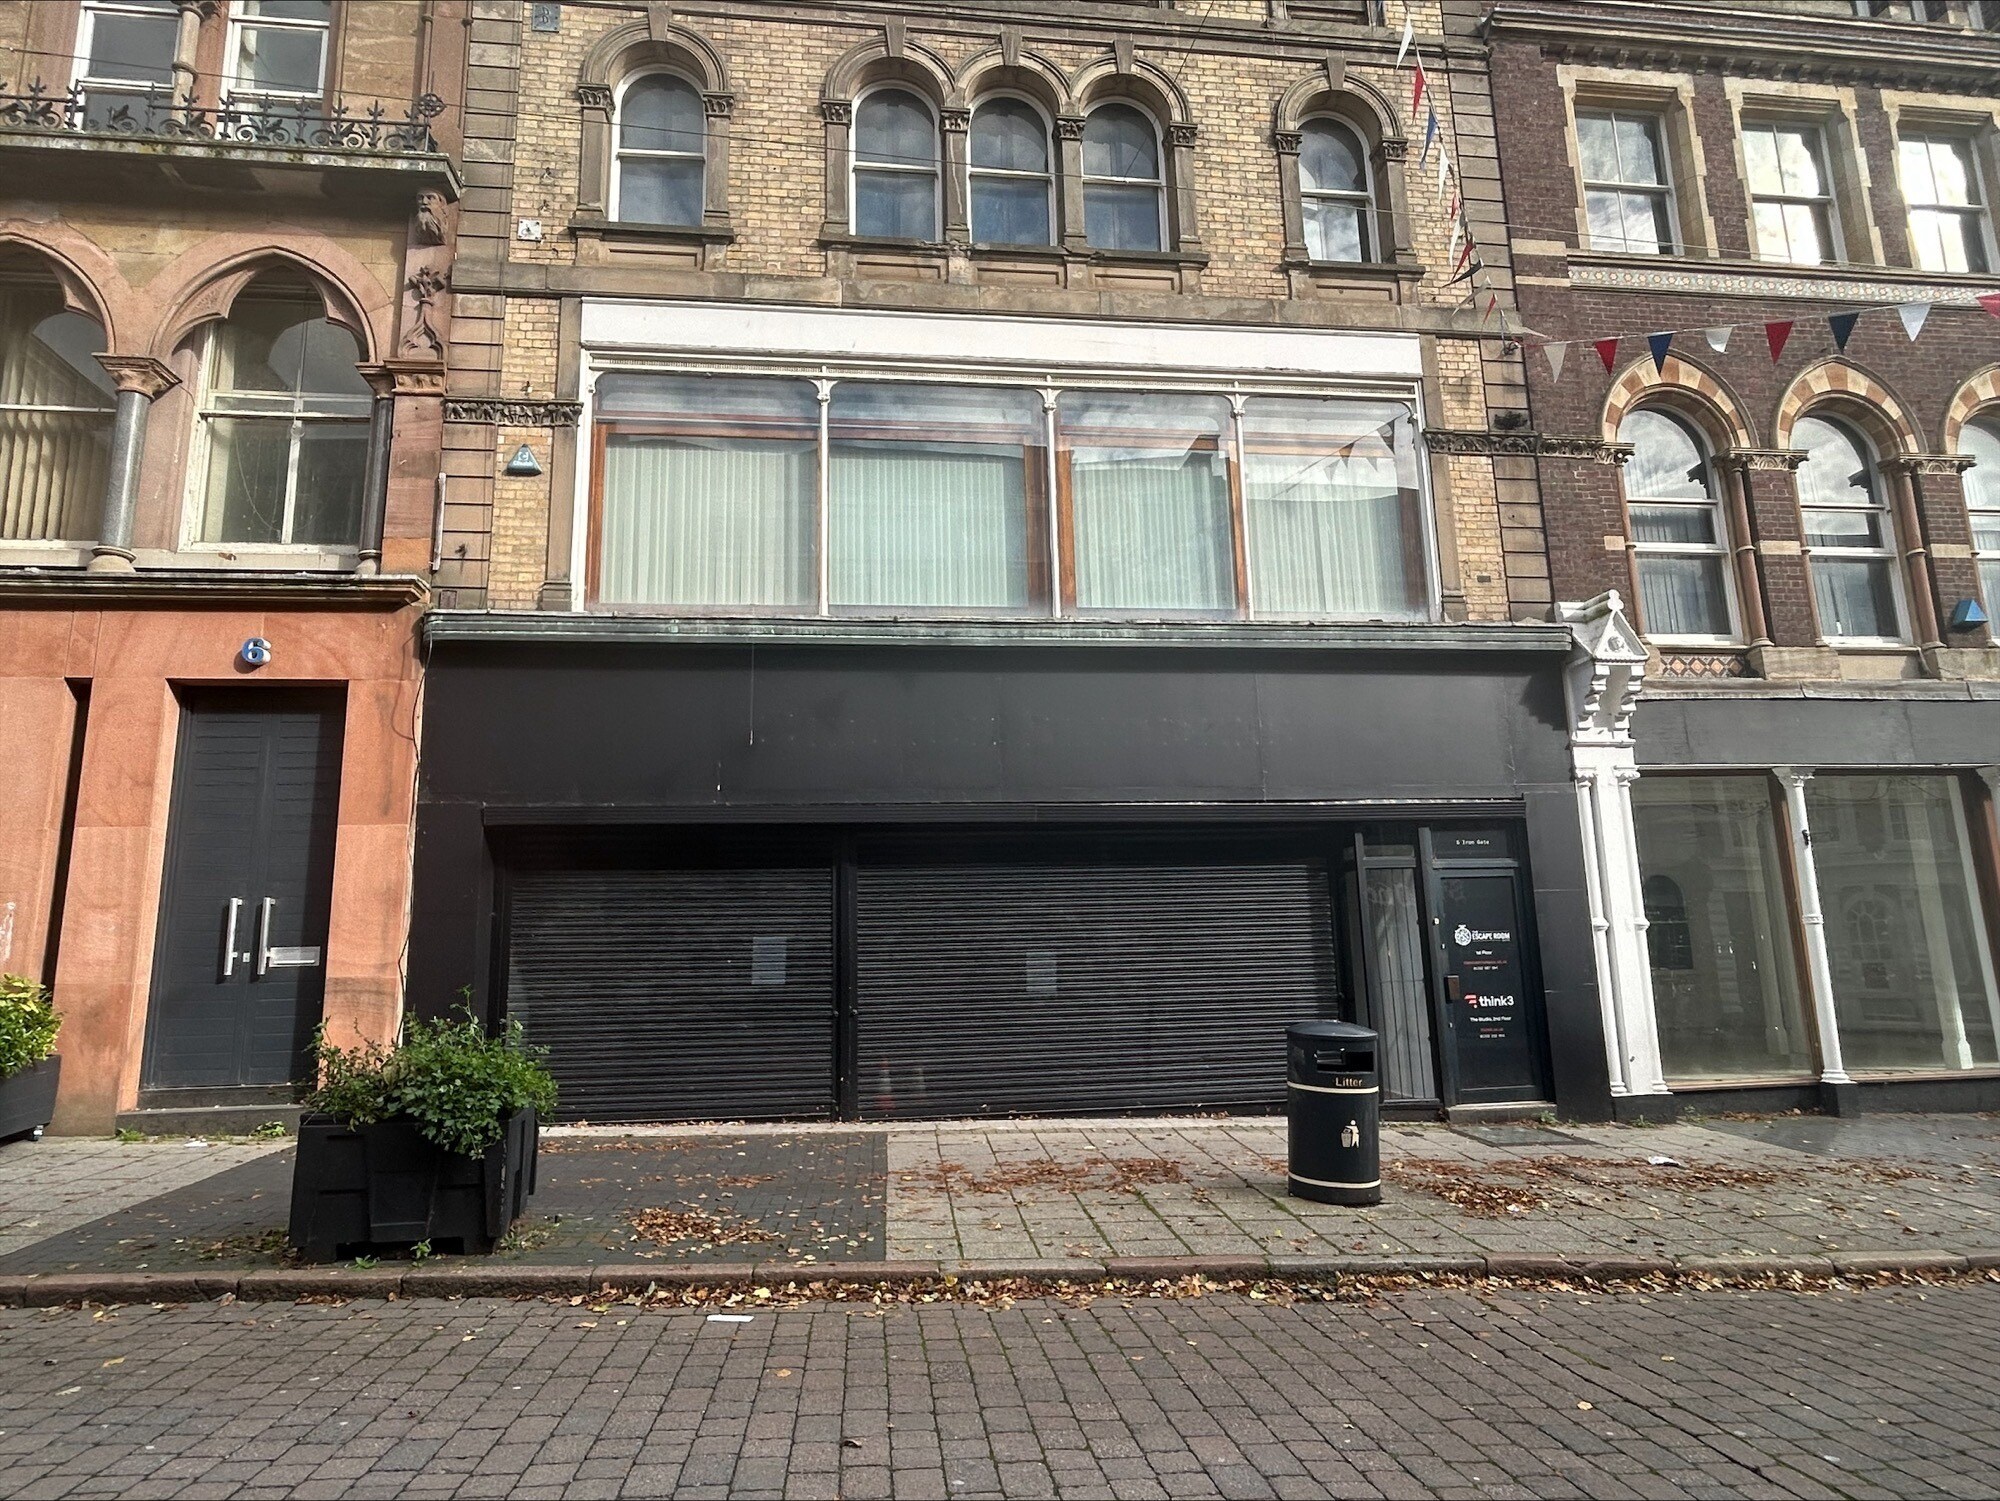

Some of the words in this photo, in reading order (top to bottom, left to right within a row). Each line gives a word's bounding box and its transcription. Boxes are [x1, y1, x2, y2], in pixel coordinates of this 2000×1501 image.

[242, 637, 272, 666] 6
[1472, 932, 1492, 940] ESCAPE
[1493, 932, 1510, 940] ROOM
[1479, 995, 1514, 1007] think3
[1335, 1077, 1363, 1087] Litter
